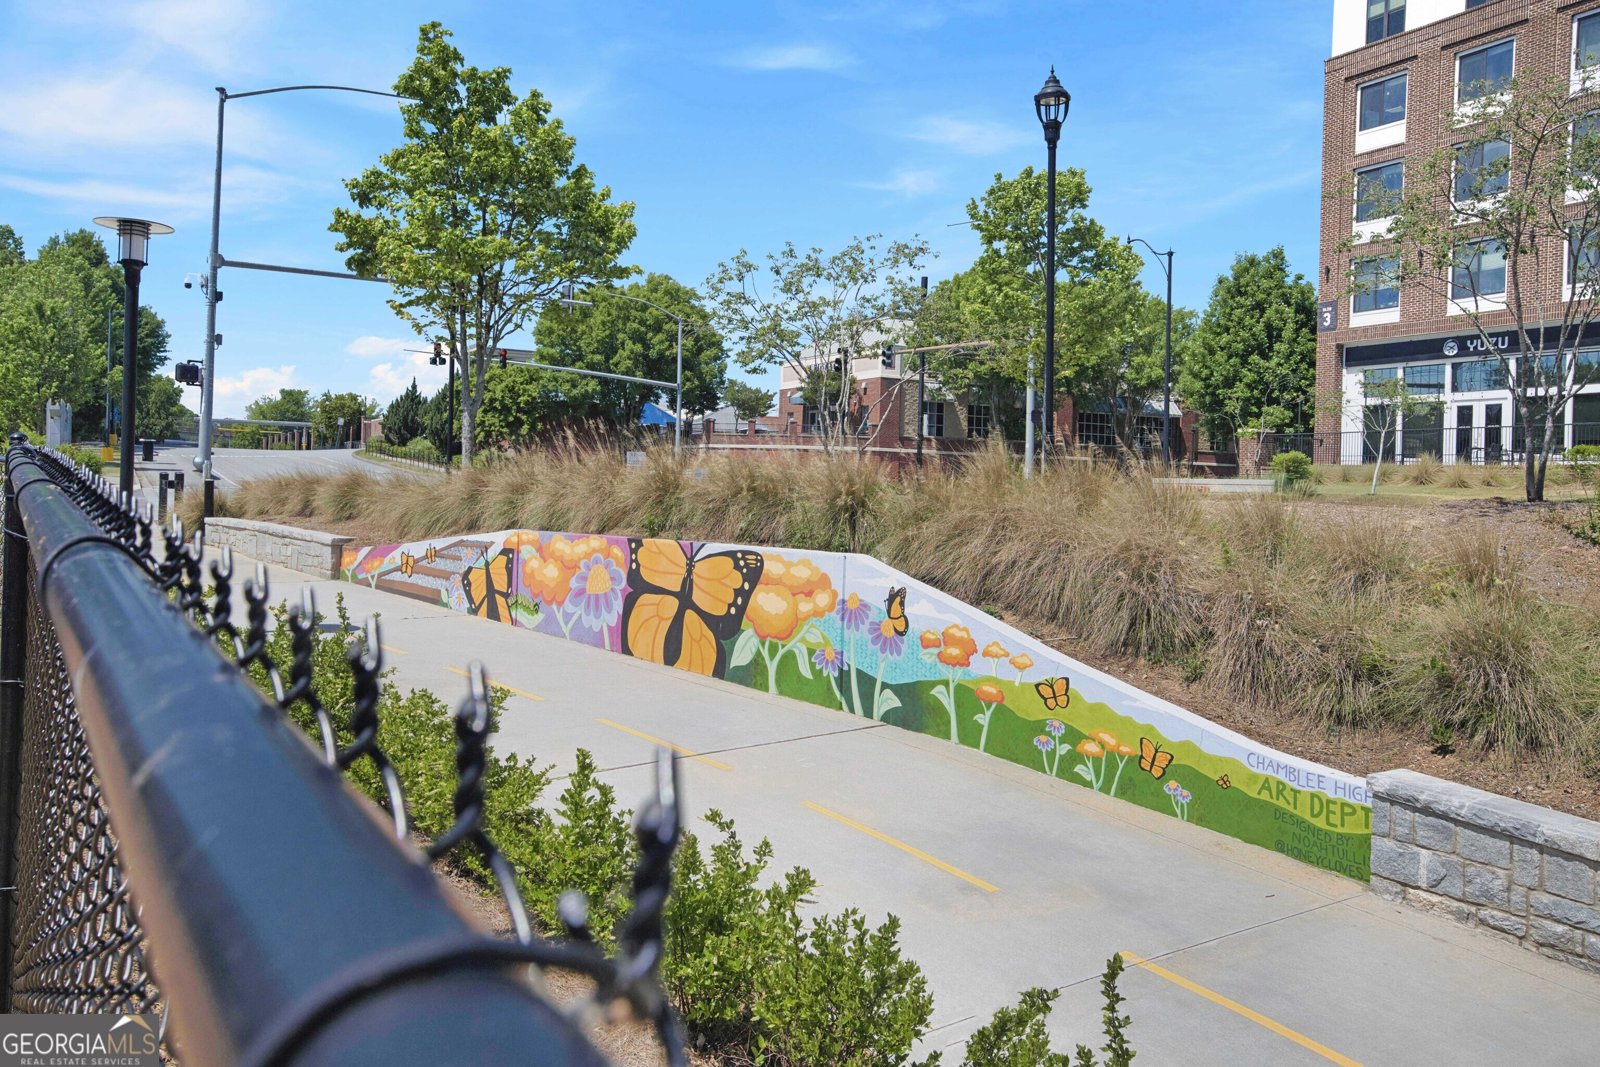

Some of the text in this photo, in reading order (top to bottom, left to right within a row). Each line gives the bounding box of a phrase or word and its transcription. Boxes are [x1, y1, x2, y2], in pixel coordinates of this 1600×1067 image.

[1322, 312, 1331, 326] 3
[1466, 336, 1509, 351] YUZU
[1246, 752, 1326, 790] CHAMBLEE
[1257, 777, 1373, 829] ART DEPT
[1274, 808, 1355, 847] DESIGNED BY:
[1328, 845, 1370, 868] TULLI
